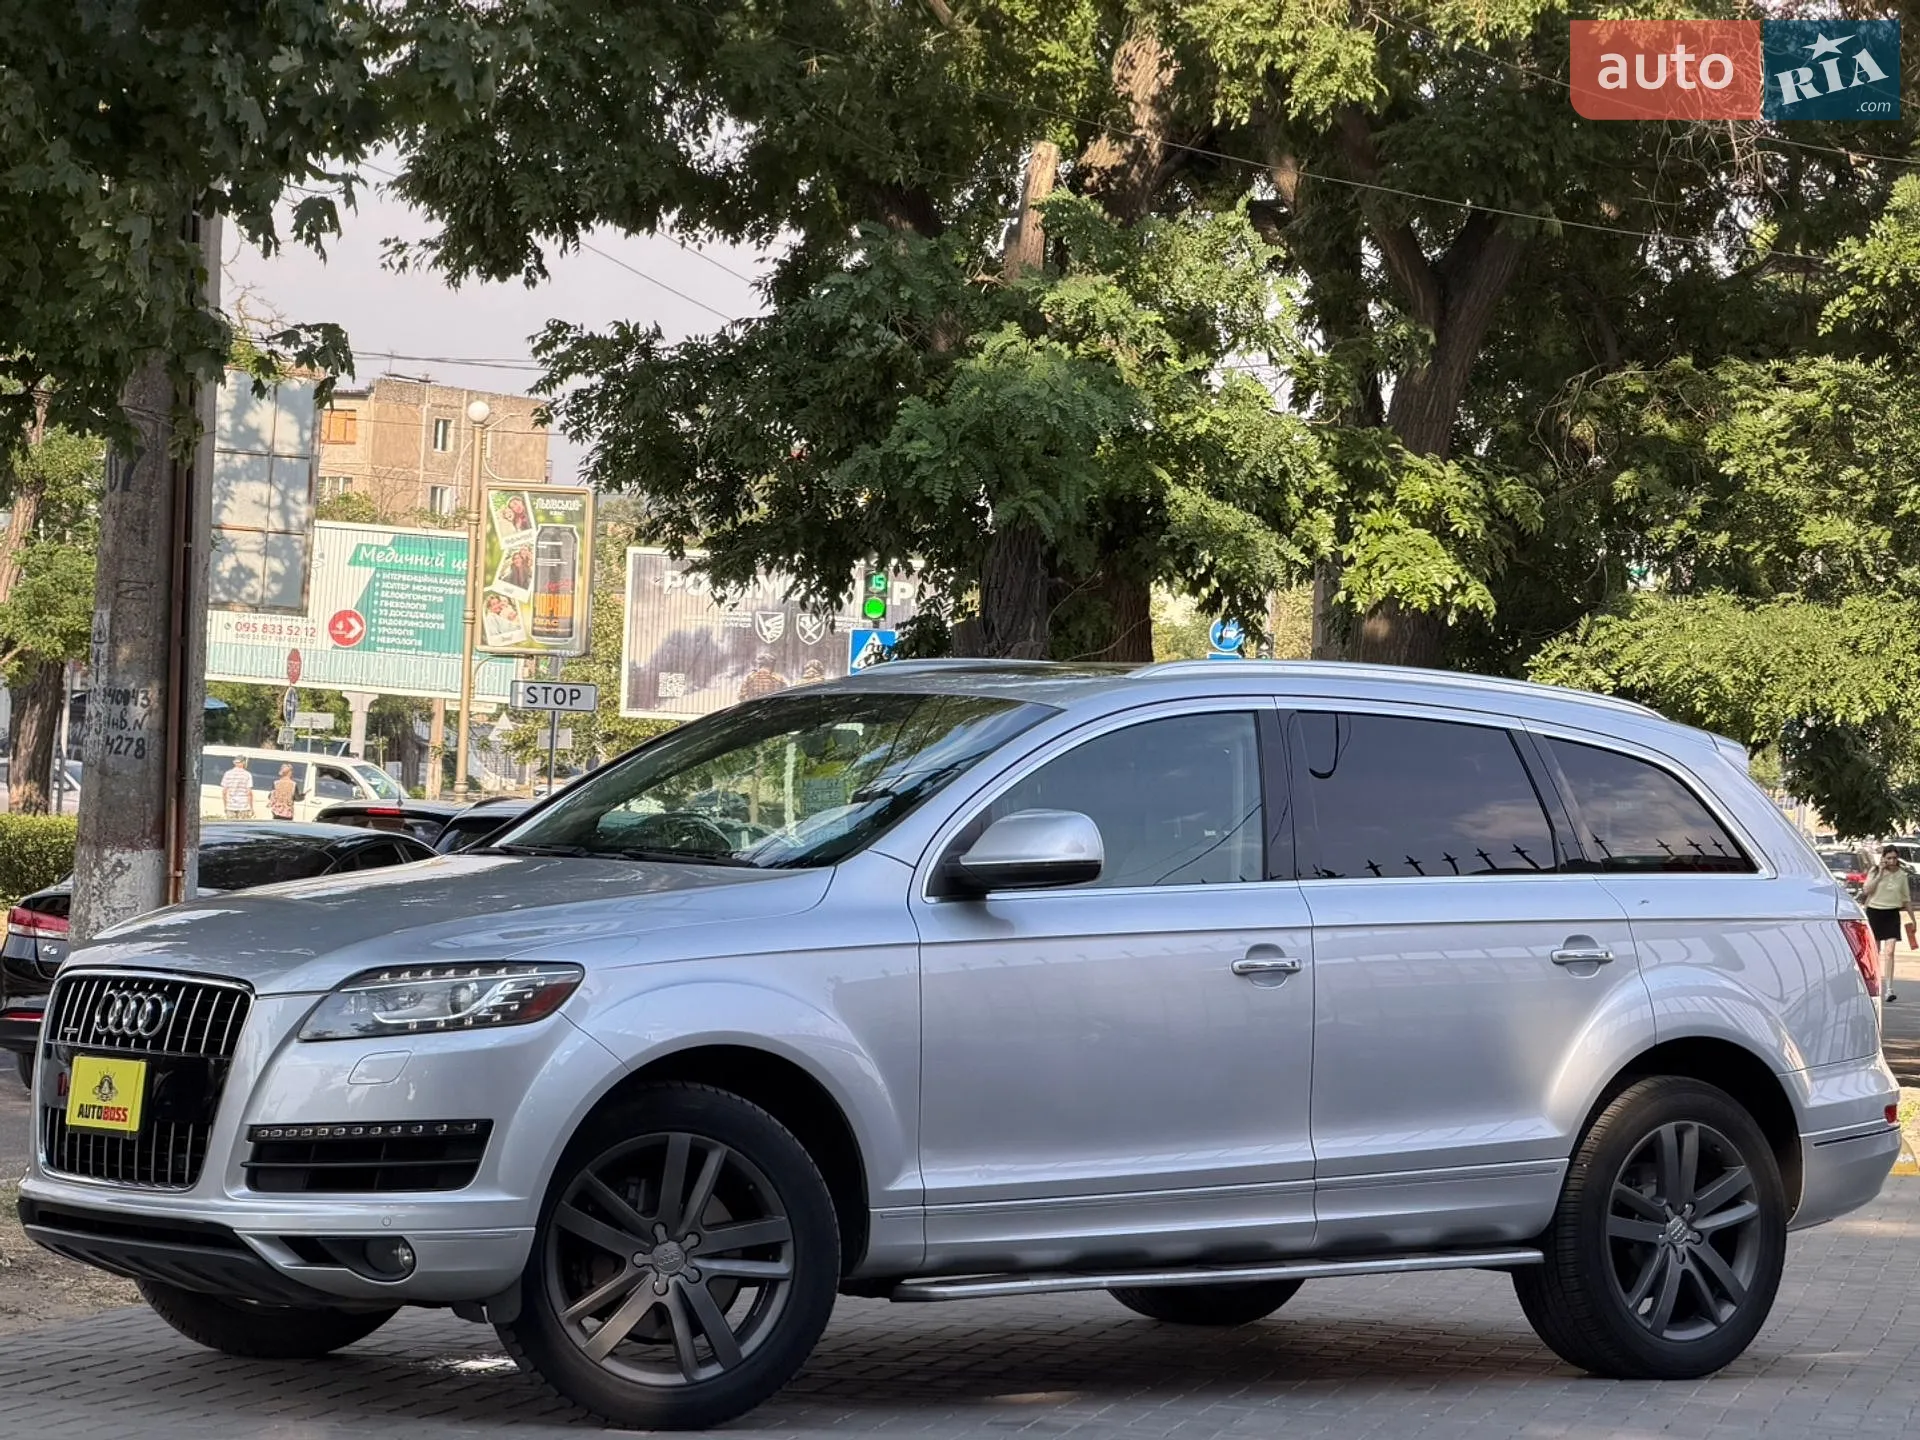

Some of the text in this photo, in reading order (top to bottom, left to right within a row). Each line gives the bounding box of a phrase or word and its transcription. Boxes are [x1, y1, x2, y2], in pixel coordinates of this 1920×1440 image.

[359, 545, 446, 568] Медичний
[234, 621, 317, 638] 095 833 52 12
[526, 686, 581, 706] STOP
[105, 735, 146, 759] 4278
[77, 1103, 129, 1122] AUTOBOSS
